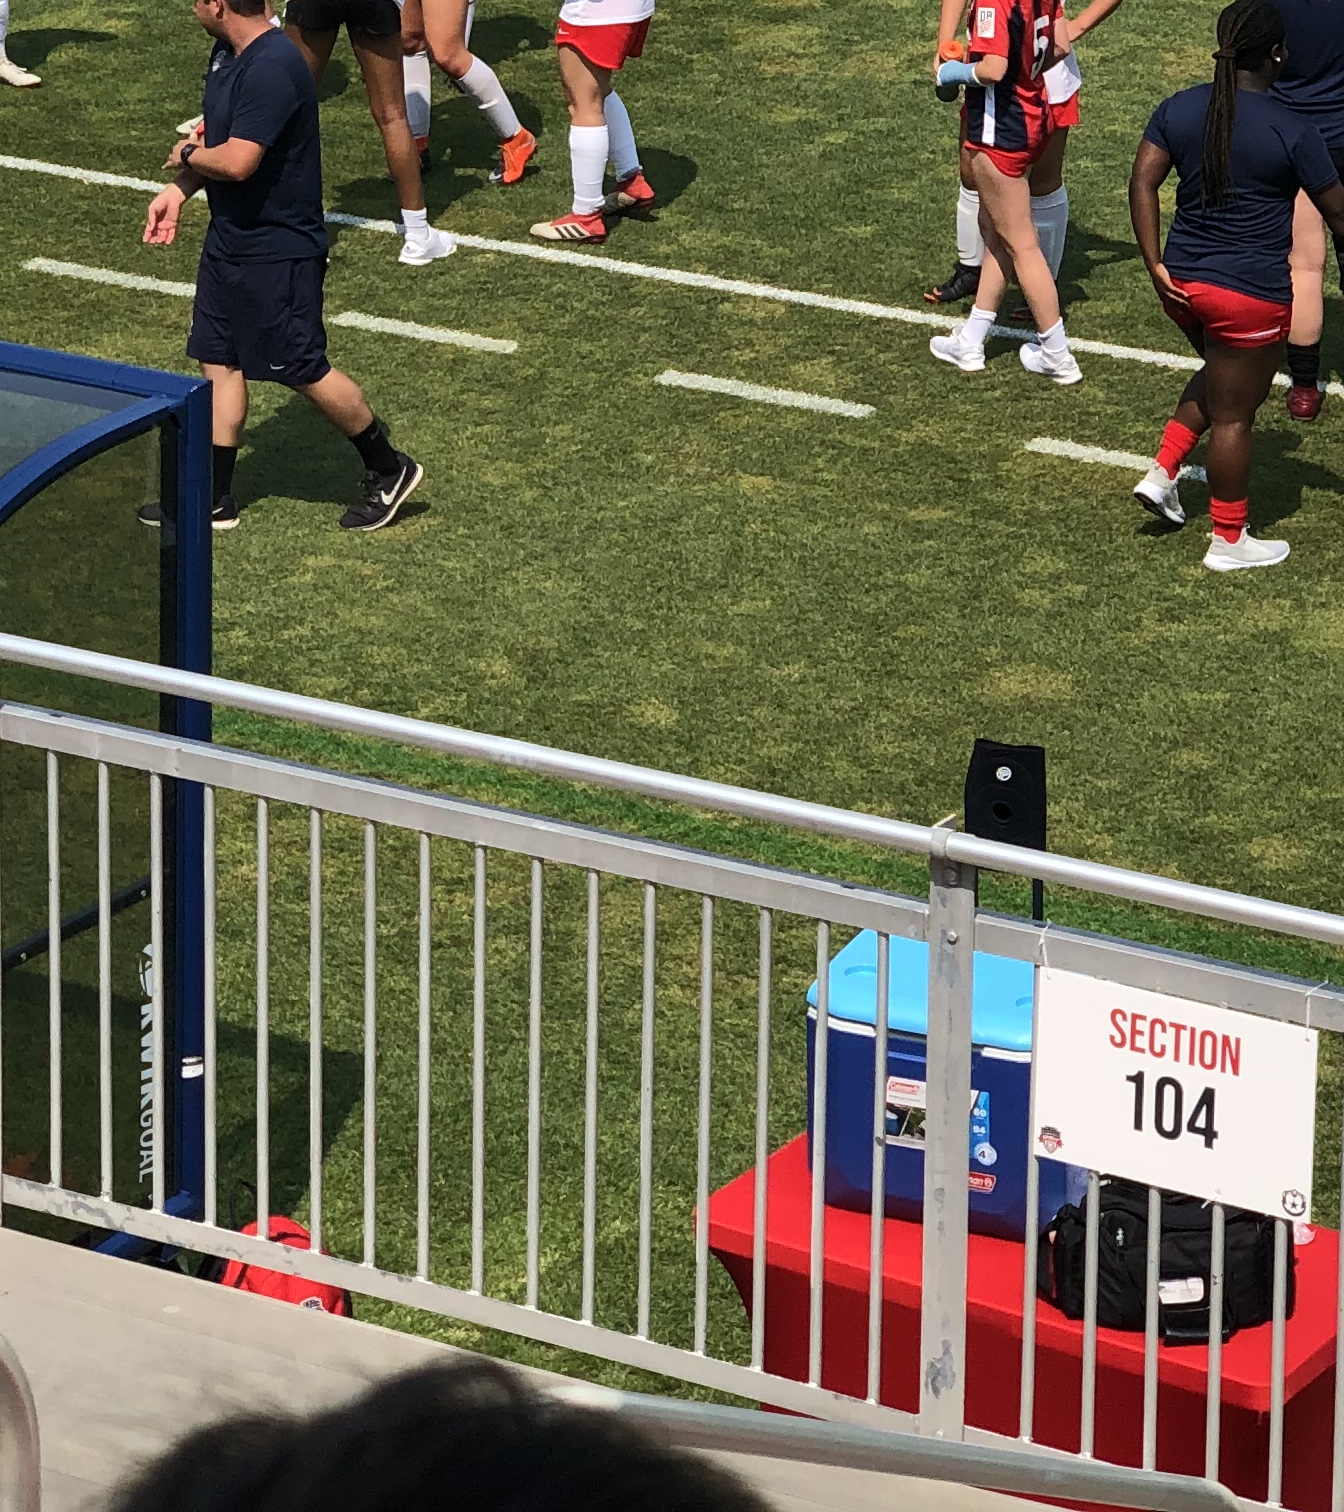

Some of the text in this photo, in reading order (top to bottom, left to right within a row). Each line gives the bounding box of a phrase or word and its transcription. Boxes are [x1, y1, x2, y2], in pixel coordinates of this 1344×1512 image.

[1030, 14, 1050, 81] 5
[1109, 1008, 1241, 1077] SECTION
[1125, 1070, 1218, 1150] 104
